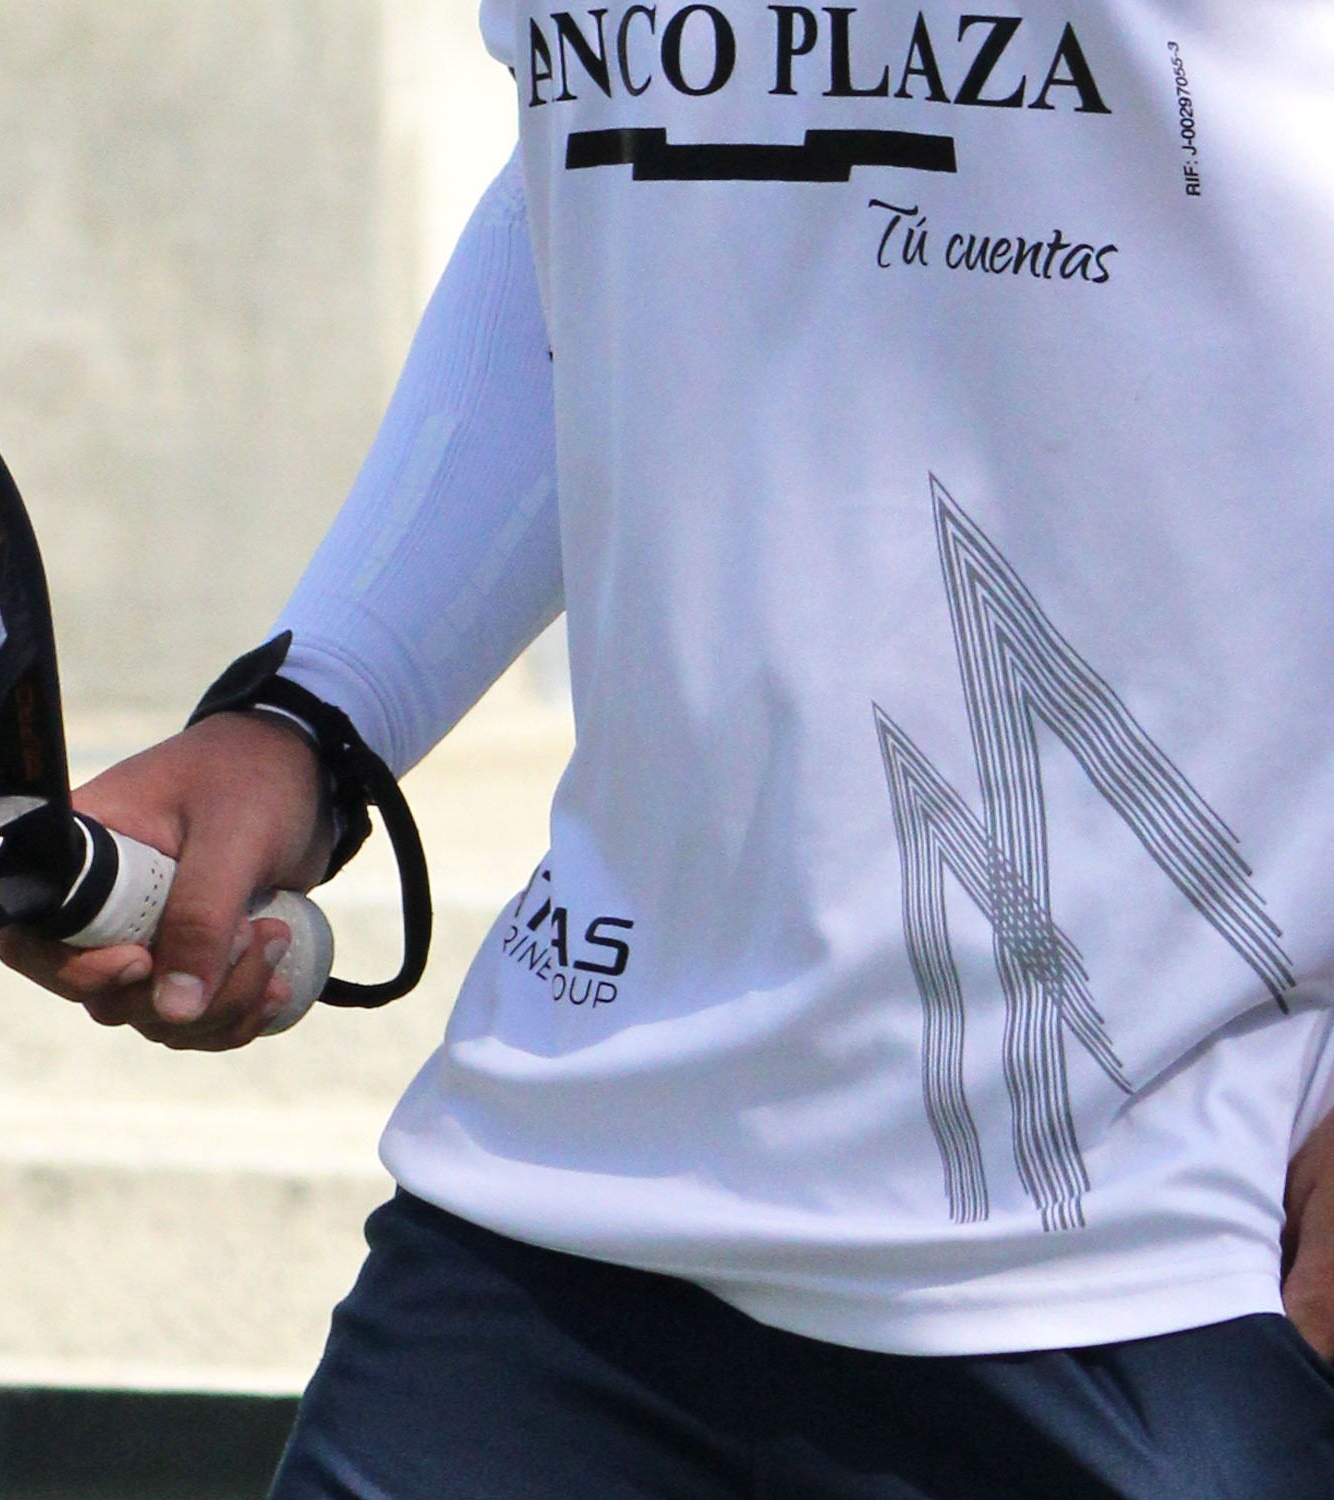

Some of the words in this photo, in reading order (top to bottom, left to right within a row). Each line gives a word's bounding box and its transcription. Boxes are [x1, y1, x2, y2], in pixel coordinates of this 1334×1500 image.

[527, 4, 737, 108] ANCO
[767, 4, 1113, 115] PLAZA
[1183, 161, 1201, 197] RIF:
[868, 199, 928, 268] Tú
[945, 229, 1118, 284] cuentas
[527, 897, 634, 976] AS
[552, 972, 617, 1009] OUP
